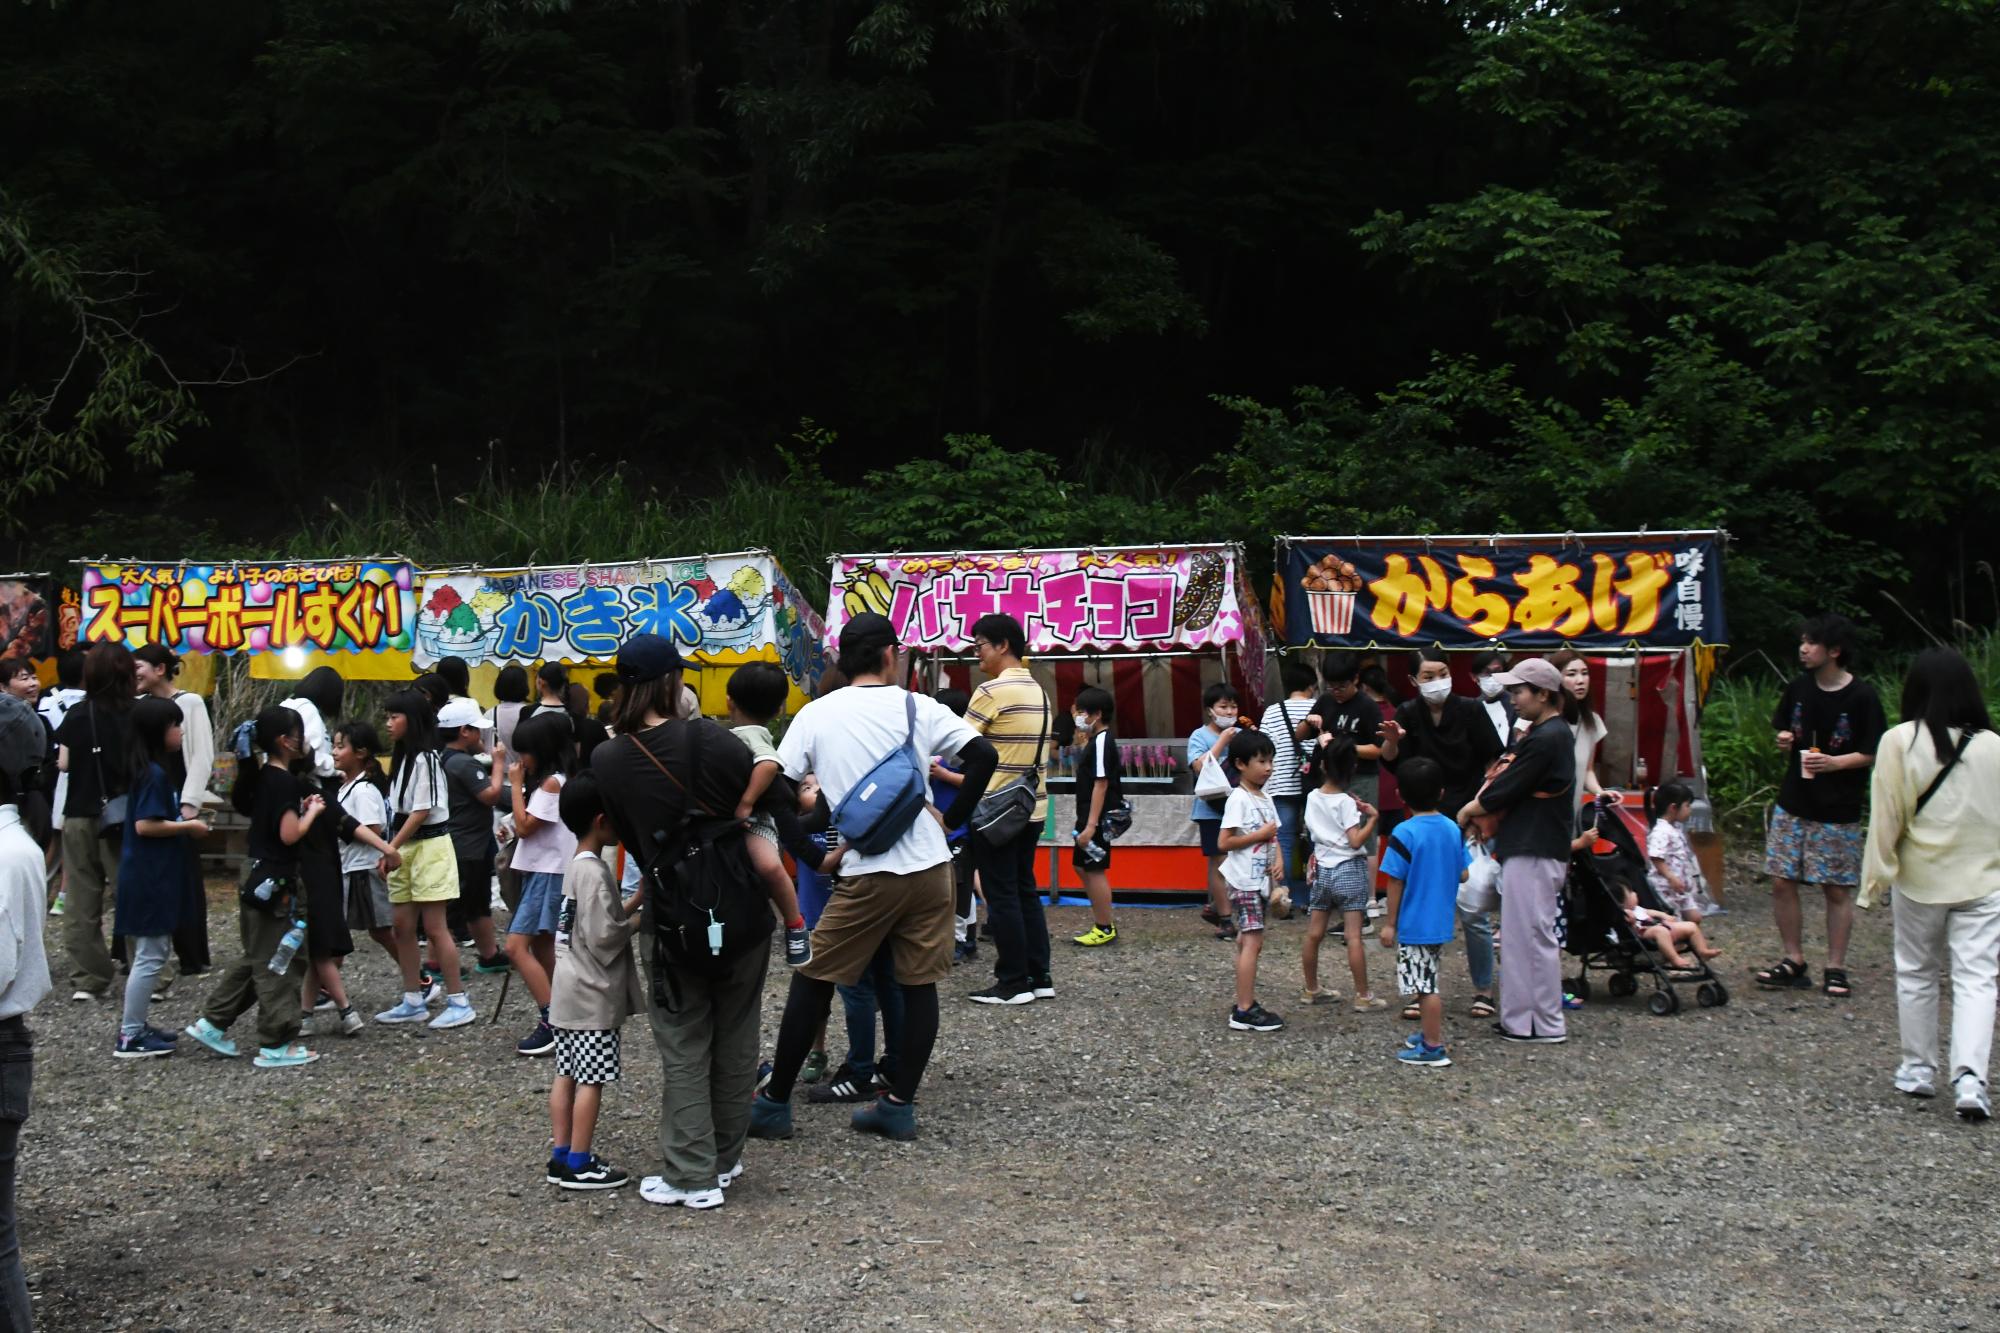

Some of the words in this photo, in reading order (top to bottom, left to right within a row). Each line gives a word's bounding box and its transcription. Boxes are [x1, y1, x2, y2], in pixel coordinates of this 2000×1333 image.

[85, 581, 402, 650] スーパーボールすくい
[479, 571, 579, 594] JAPANESE
[585, 565, 667, 587] SHAVED
[672, 563, 708, 583] ICE
[889, 570, 1178, 643] バナナチョコ
[1369, 551, 1675, 638] からあげ
[1674, 547, 1705, 631] 味自慢
[494, 578, 704, 659] かき氷
